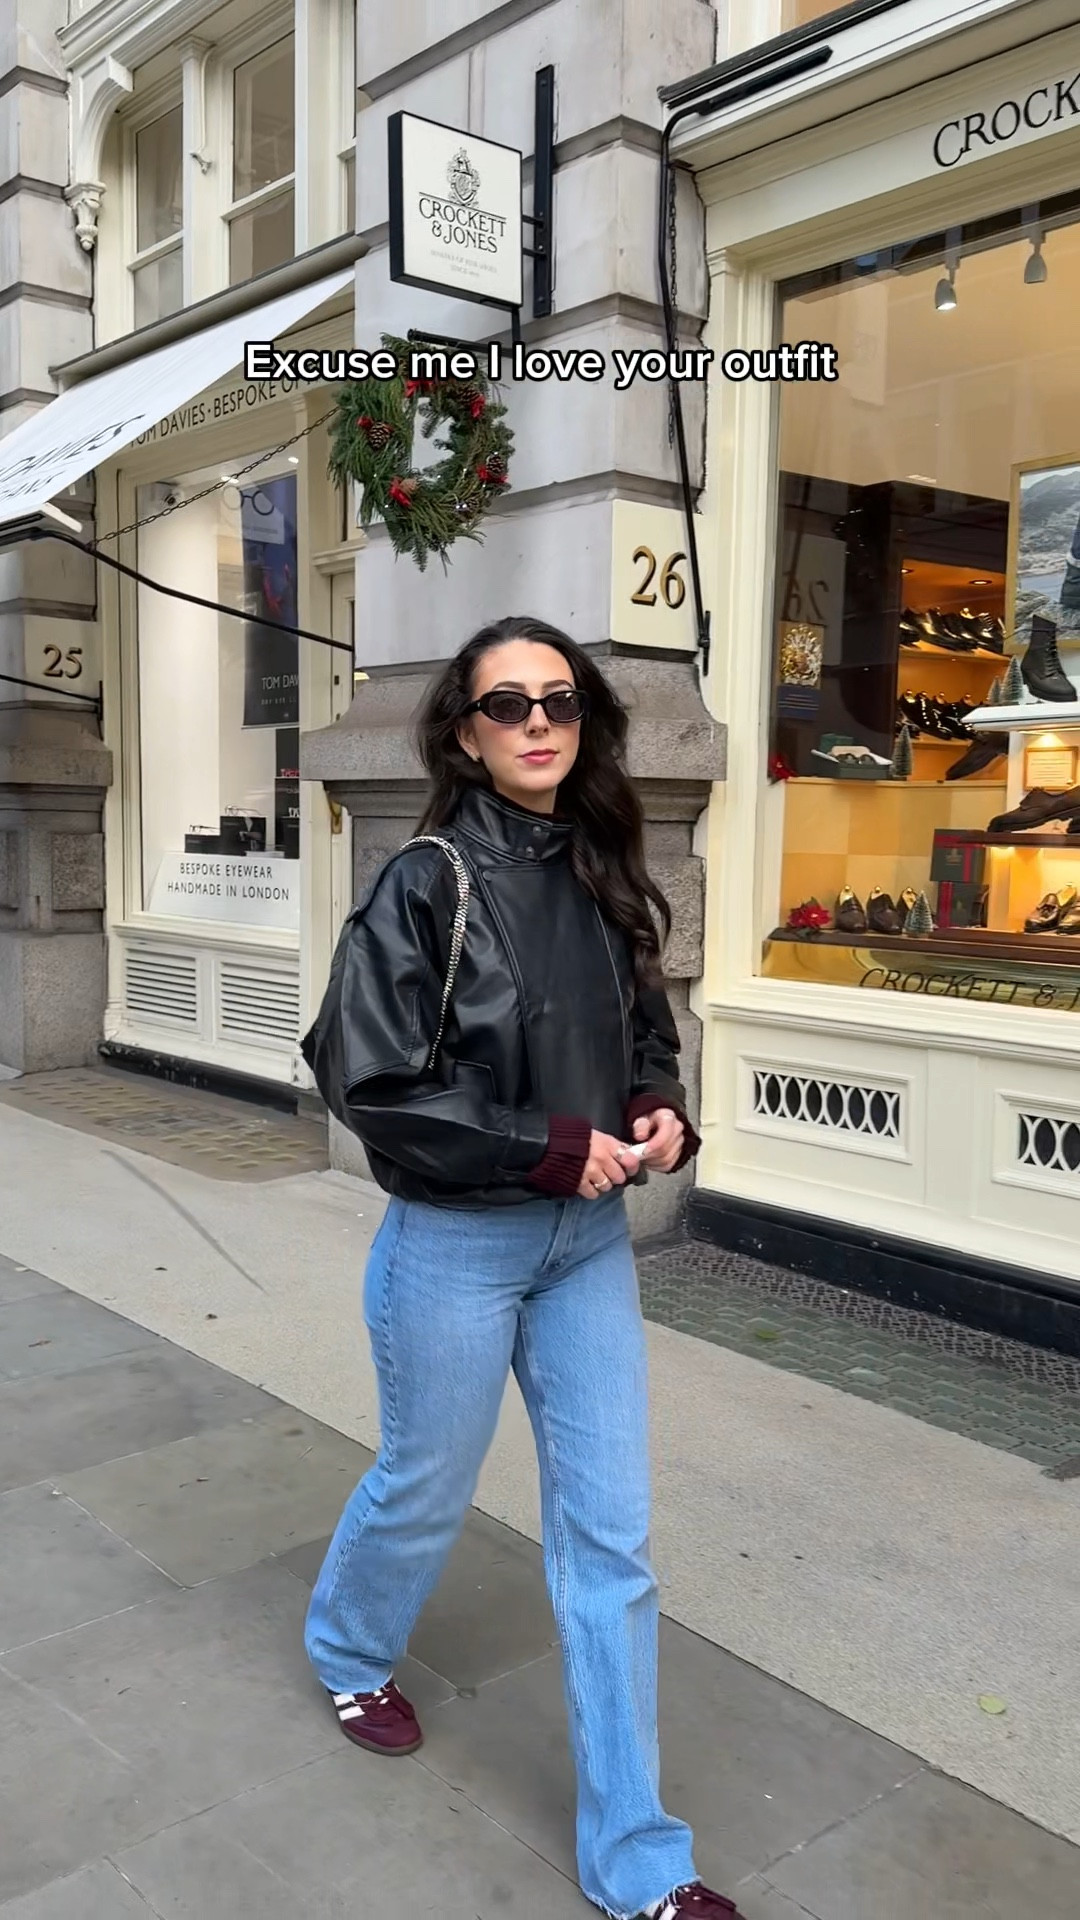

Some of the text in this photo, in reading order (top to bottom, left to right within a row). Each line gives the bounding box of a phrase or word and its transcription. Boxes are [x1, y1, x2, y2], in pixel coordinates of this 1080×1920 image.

[933, 73, 1080, 167] CROCK
[419, 197, 506, 237] CROCKETT
[431, 220, 498, 253] & JONES
[213, 383, 277, 418] BESPOKE
[630, 545, 688, 610] 26
[43, 643, 83, 679] 25
[261, 675, 281, 690] TOM
[180, 863, 273, 879] BESPOKE EYEWEAR
[167, 882, 289, 901] HANDMADE IN LONDON
[1032, 983, 1058, 1008] &
